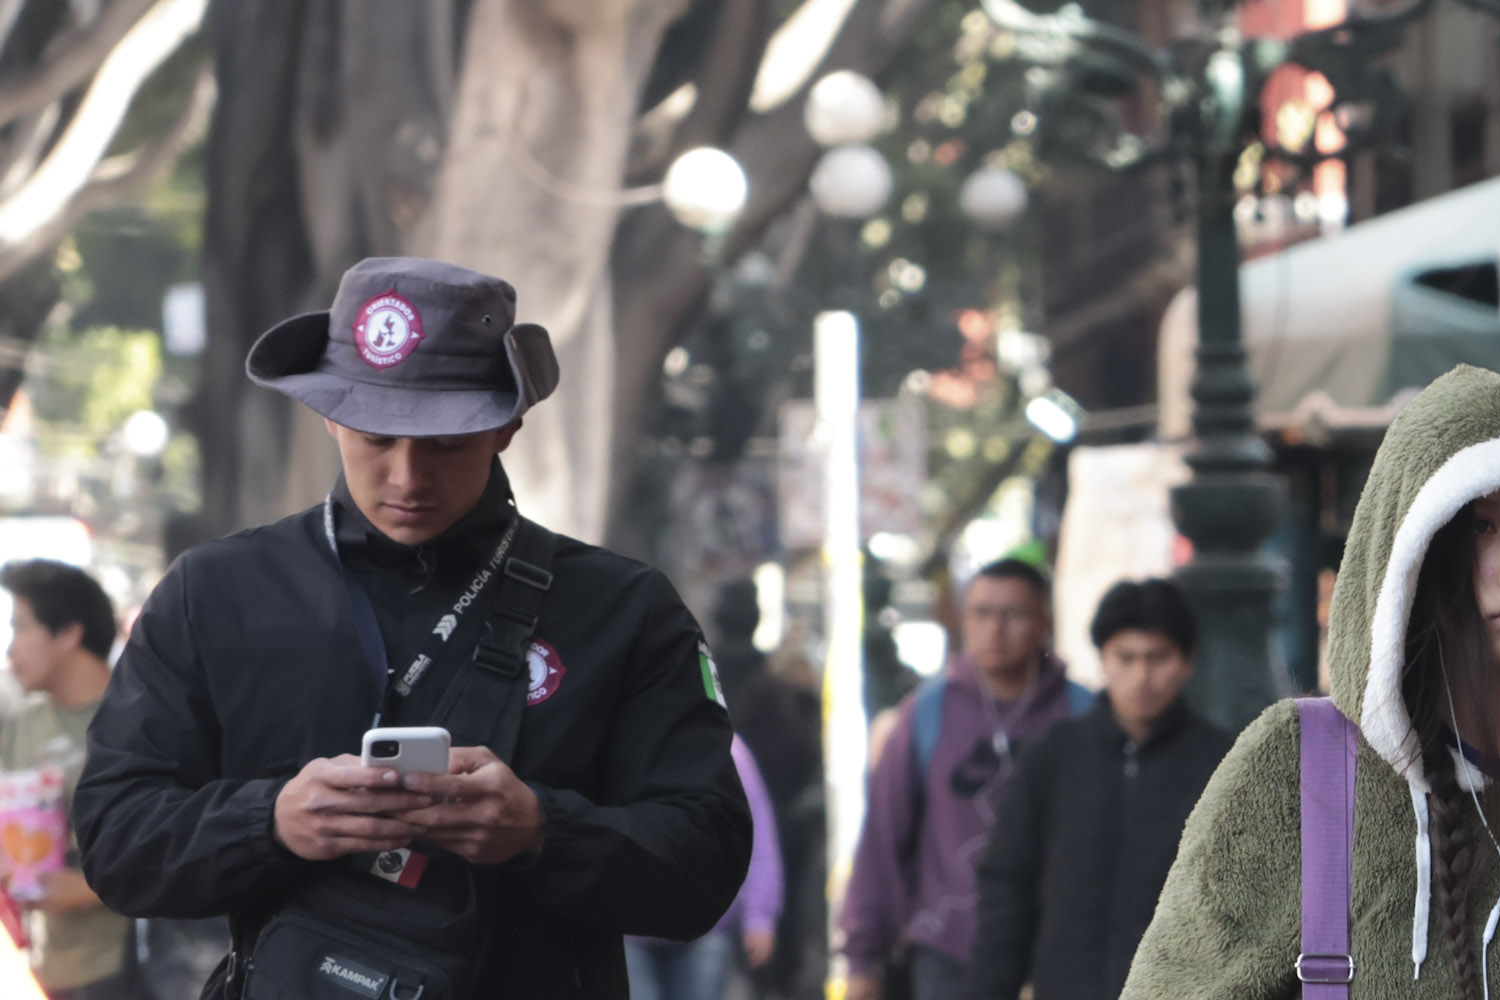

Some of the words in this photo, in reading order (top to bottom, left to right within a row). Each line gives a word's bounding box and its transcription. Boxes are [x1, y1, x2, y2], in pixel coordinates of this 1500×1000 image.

[366, 297, 416, 321] ORIENTADOR
[453, 569, 492, 614] POLICÍA
[331, 964, 381, 991] KAMPAK
